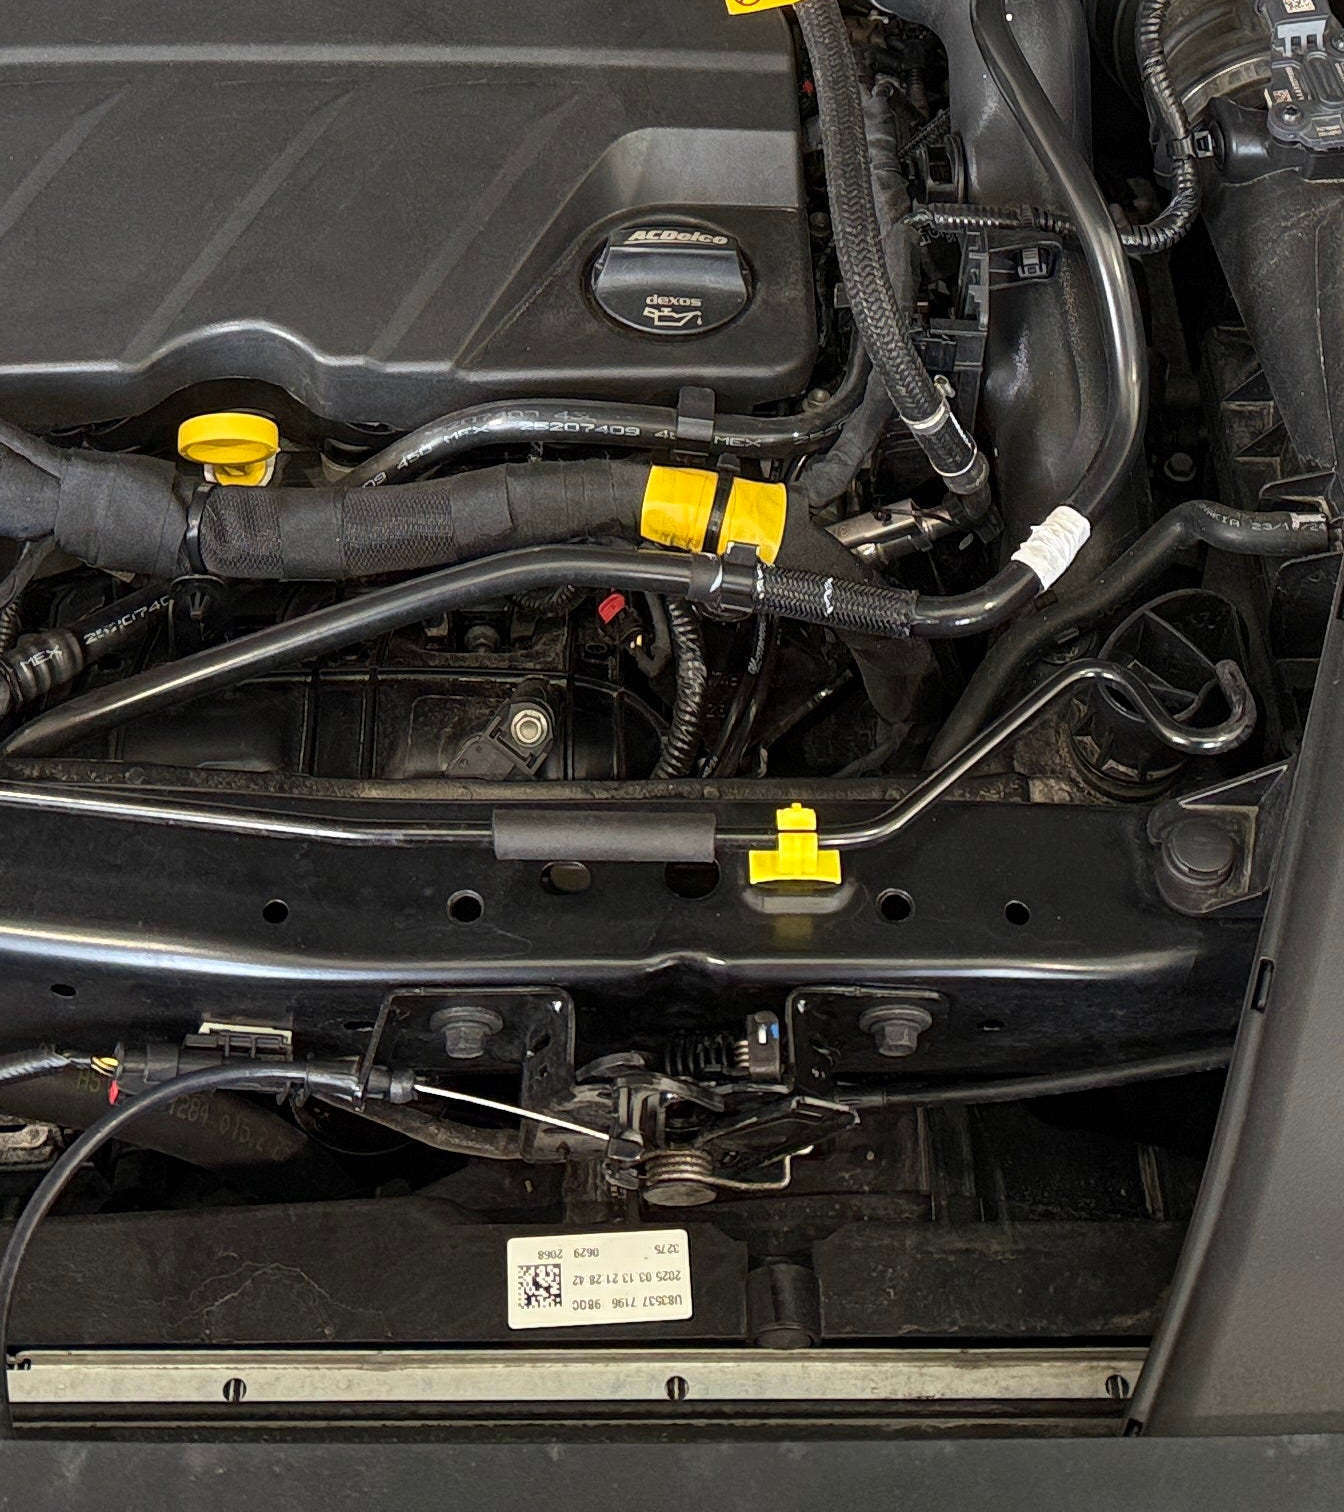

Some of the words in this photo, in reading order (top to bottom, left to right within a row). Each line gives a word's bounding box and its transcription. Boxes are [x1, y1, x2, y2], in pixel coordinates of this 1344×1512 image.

[627, 230, 729, 245] ACDelco
[645, 293, 702, 307] dexos
[518, 420, 641, 438] 25207409
[714, 434, 762, 449] MEX
[19, 643, 64, 674] MEX
[537, 1248, 564, 1260] 2068
[573, 1247, 600, 1258] 0629
[653, 1242, 680, 1255] 3275
[611, 1296, 637, 1310] 7196
